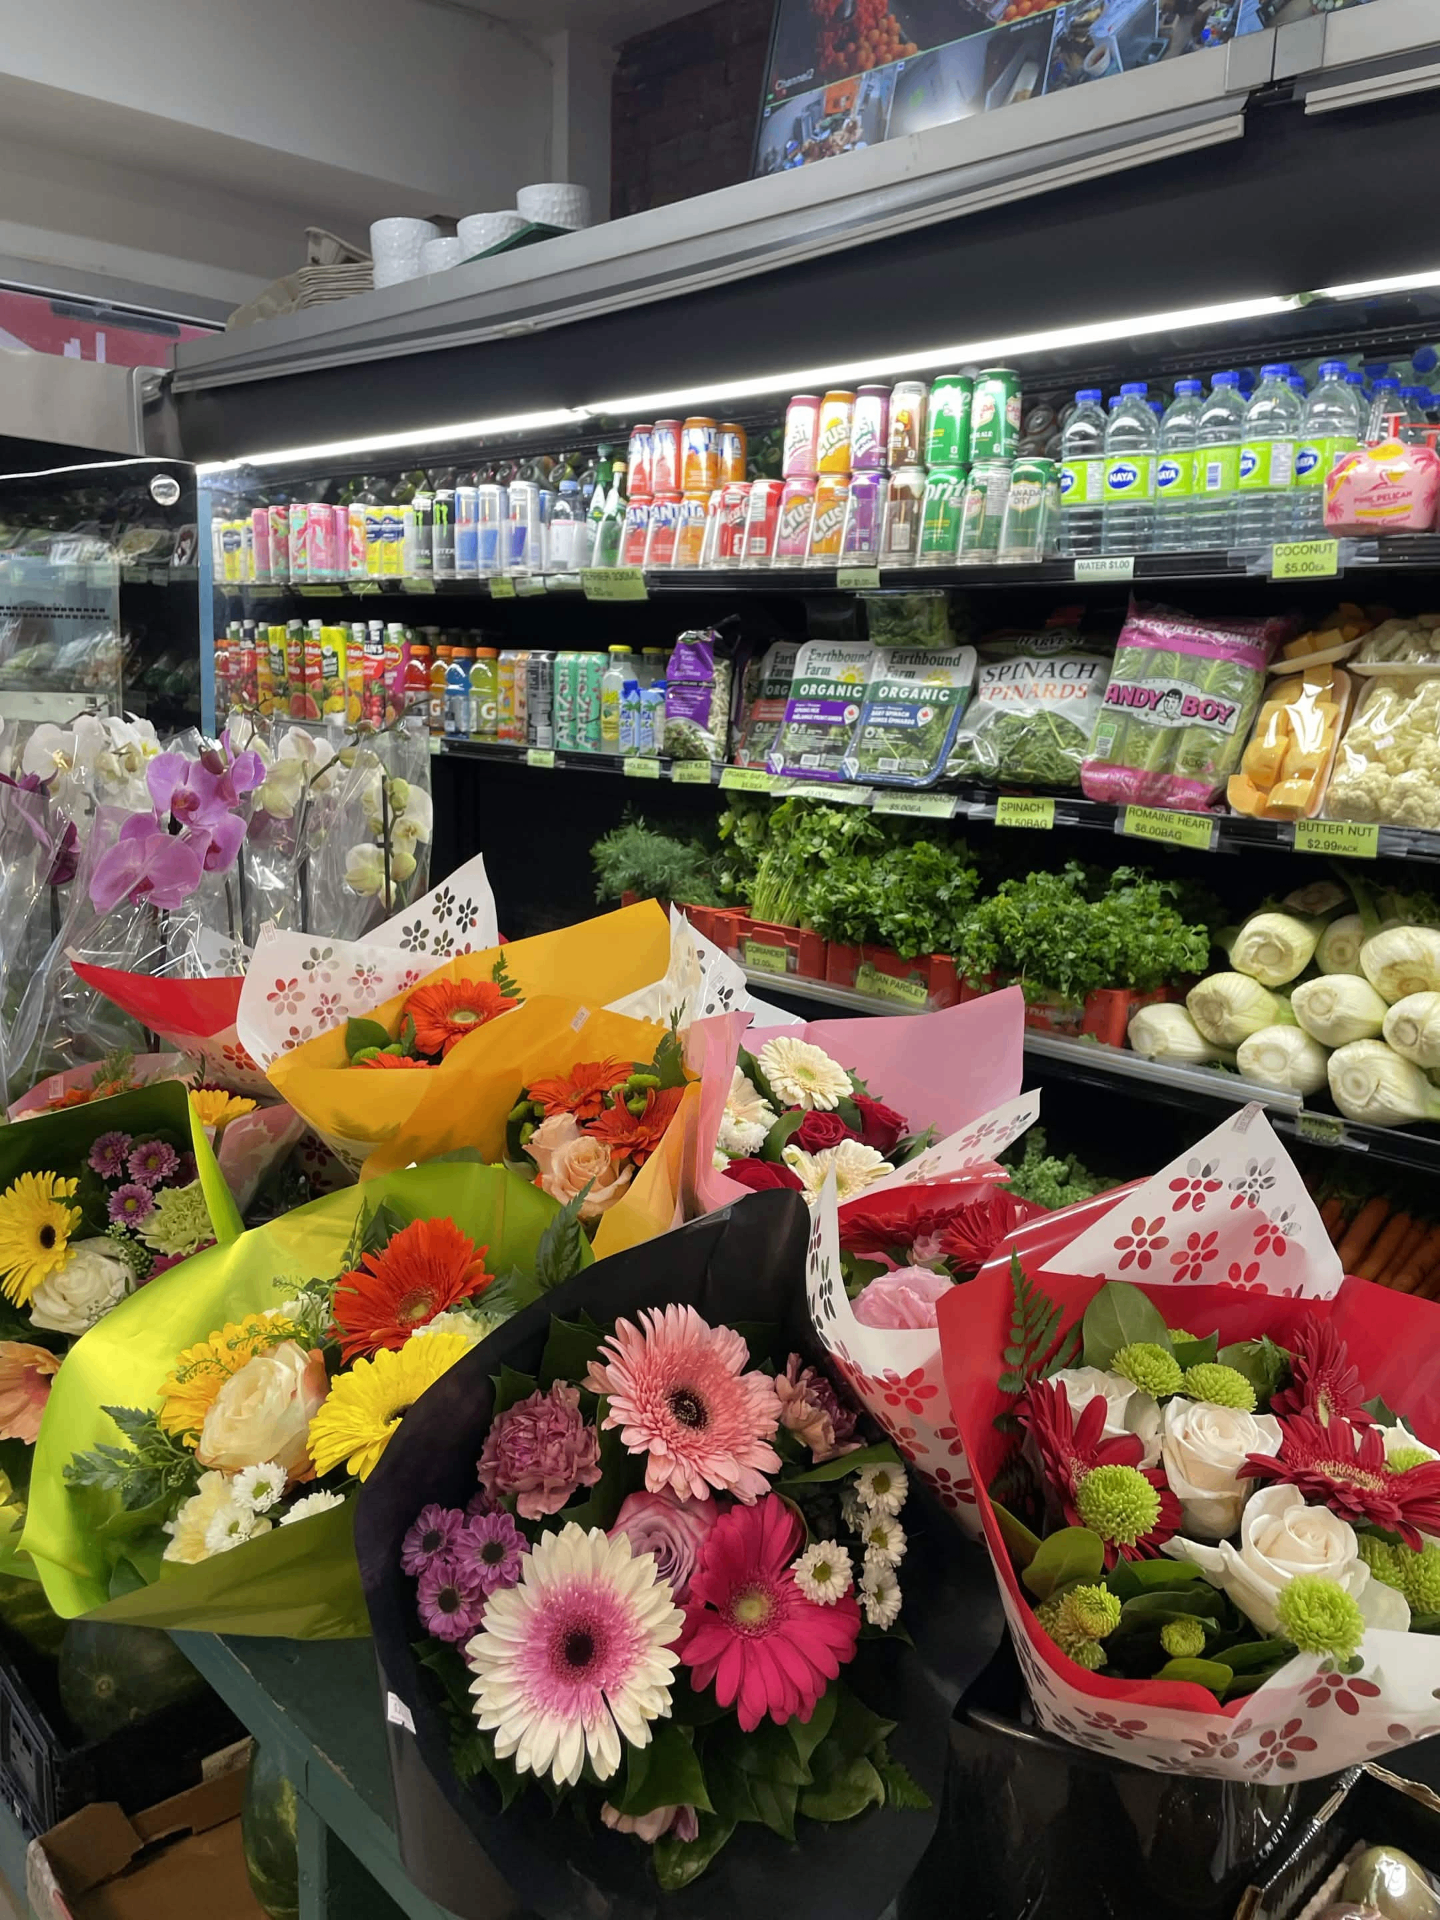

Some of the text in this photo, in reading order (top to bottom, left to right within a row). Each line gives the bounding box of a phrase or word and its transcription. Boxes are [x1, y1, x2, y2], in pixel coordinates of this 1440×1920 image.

[1109, 472, 1134, 482] NAYA
[926, 480, 965, 500] prit
[780, 501, 812, 538] Crus
[1275, 543, 1335, 556] COCONUT
[1077, 560, 1130, 570] WATER $1.00
[808, 649, 873, 663] Earthbound
[890, 651, 961, 667] Earthbound
[805, 662, 831, 675] Farm
[982, 661, 1099, 682] SPINACH
[800, 683, 863, 697] ORGANIC
[879, 686, 950, 701] ORGANIC
[979, 682, 1089, 700] ÉPINARDS
[481, 702, 496, 720] G
[1104, 683, 1236, 726] ANDY BOY
[1001, 802, 1044, 812] SPINACH
[1128, 807, 1212, 831] ROMAINE HEART
[1298, 822, 1374, 837] BUTTER NUT
[889, 979, 925, 997] PARSLEY
